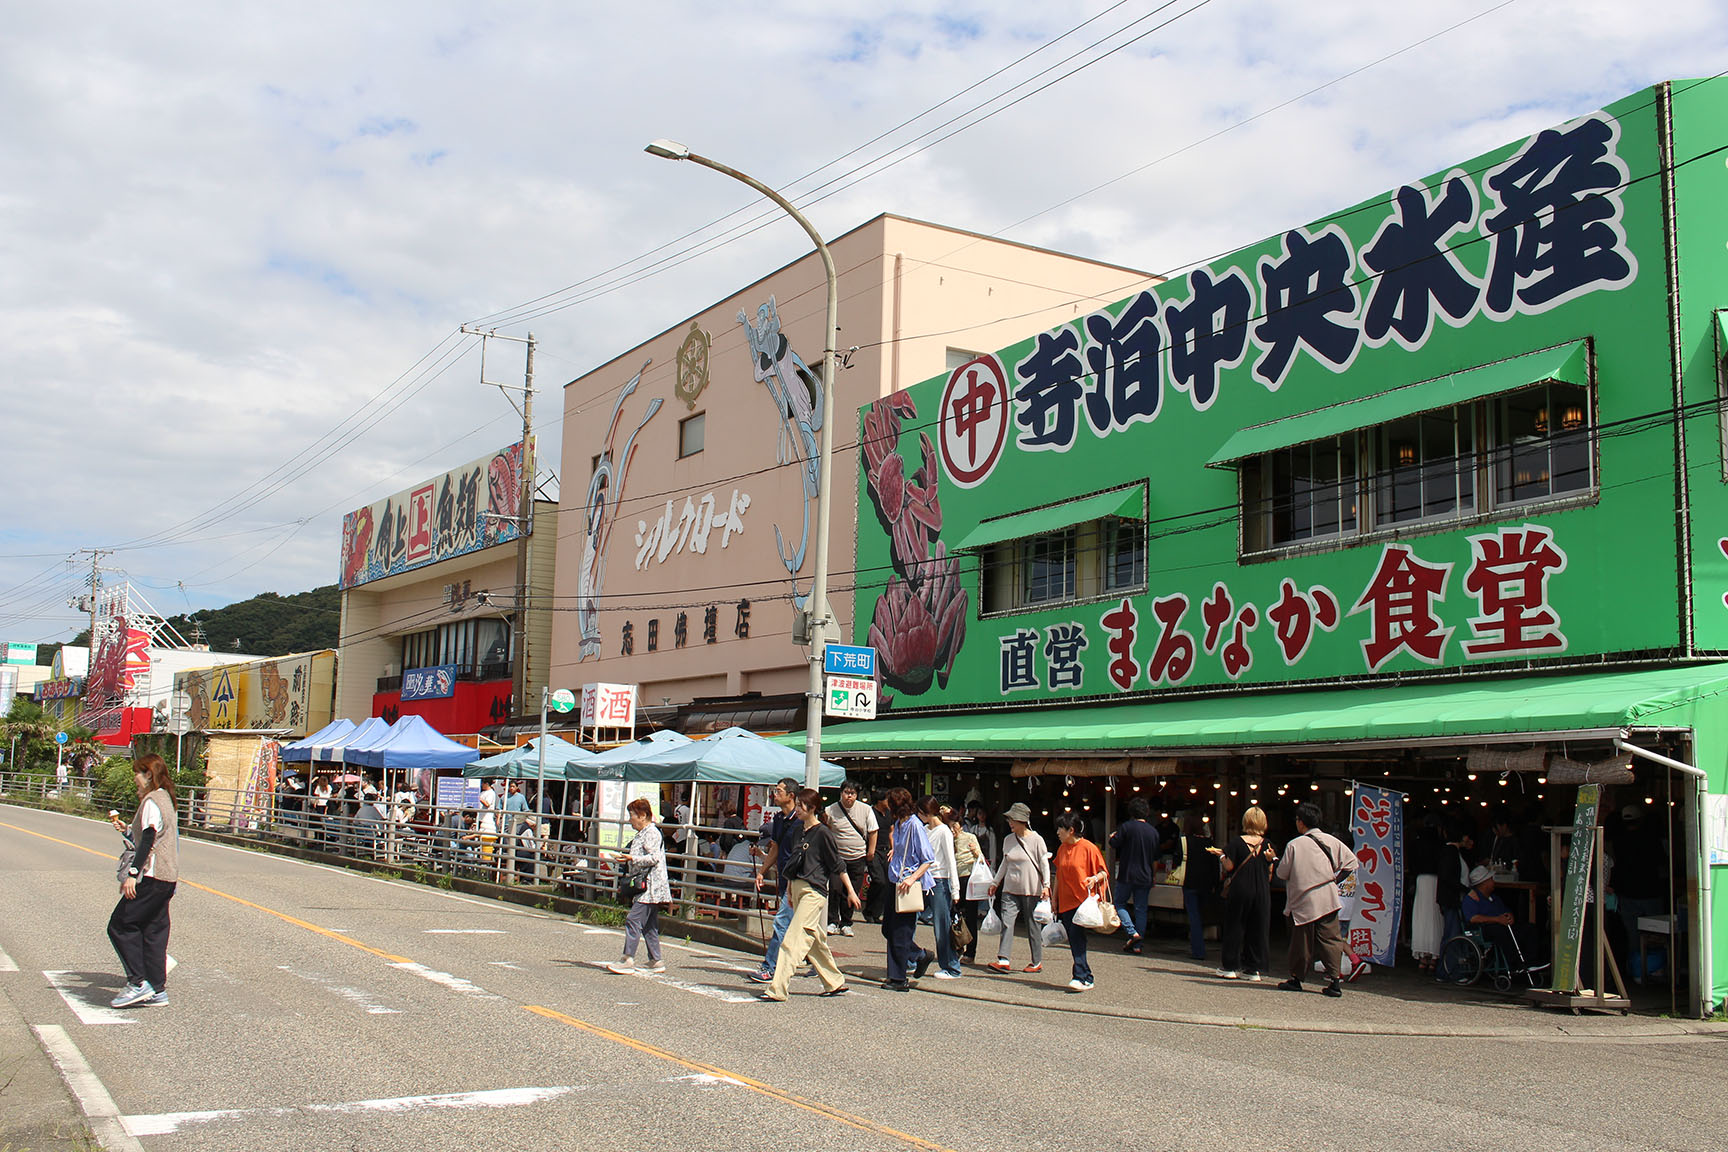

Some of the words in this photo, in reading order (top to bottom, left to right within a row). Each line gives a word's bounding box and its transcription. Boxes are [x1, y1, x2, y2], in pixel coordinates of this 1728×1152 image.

[1016, 114, 1634, 449] 寺泊中央水産
[948, 364, 1000, 472] 中
[635, 489, 751, 571] シルクロード
[1000, 624, 1088, 694] 直営
[1099, 524, 1567, 692] まるなか食堂
[829, 651, 871, 670] 下荒町
[831, 678, 873, 691] 津波避難場所
[582, 688, 596, 721] 酒
[600, 687, 631, 723] 酒
[1355, 795, 1393, 924] 活かき
